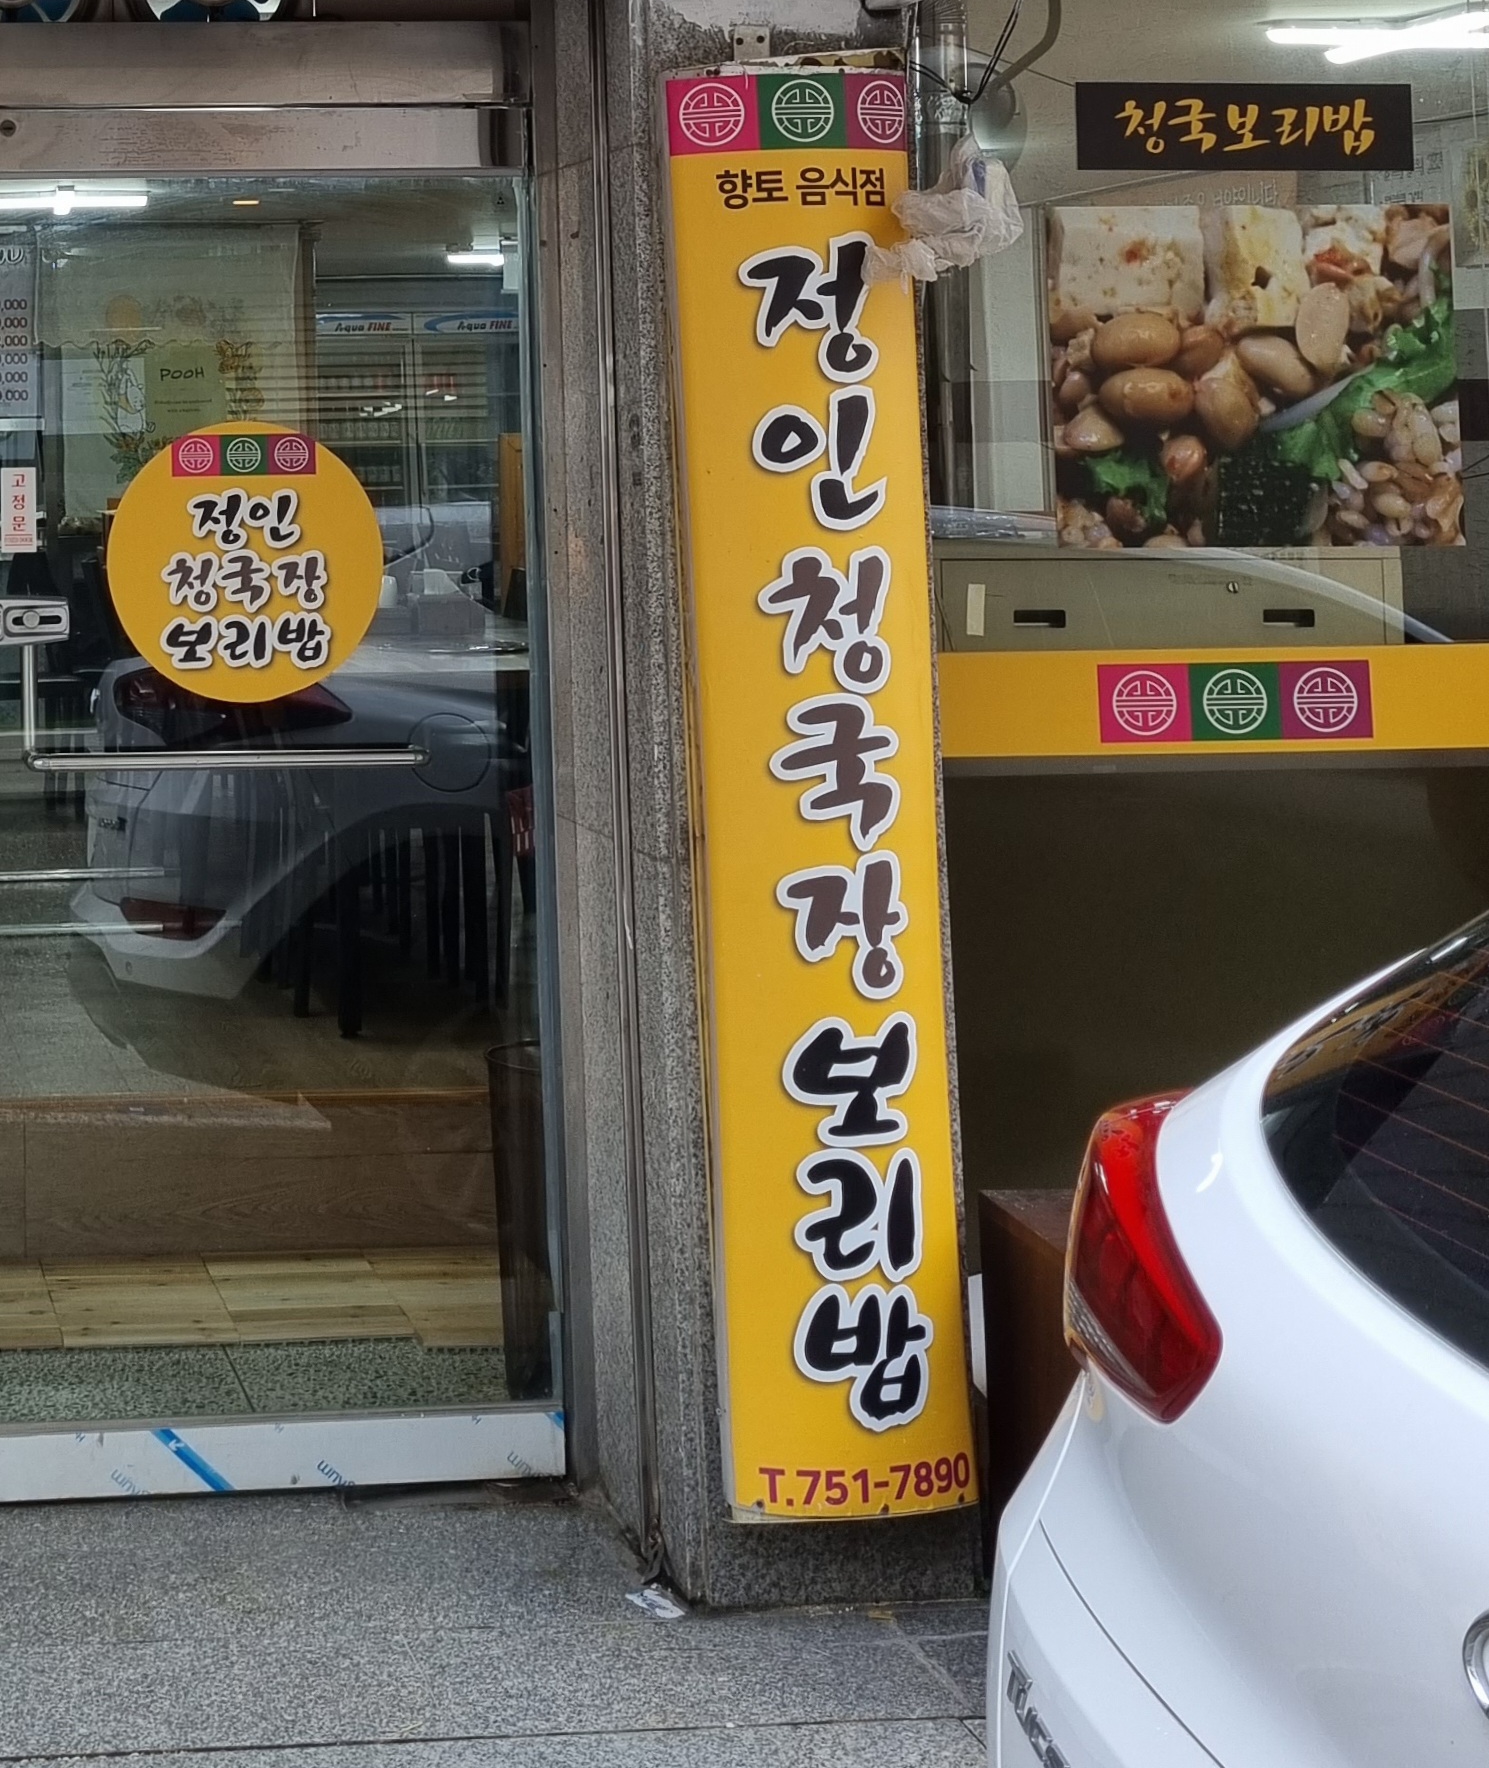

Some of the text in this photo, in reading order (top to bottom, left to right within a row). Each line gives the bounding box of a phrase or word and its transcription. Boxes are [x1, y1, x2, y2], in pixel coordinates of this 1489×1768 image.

[715, 166, 887, 210] 향토 음식점
[367, 322, 392, 331] FINE
[489, 319, 513, 330] FINE
[159, 366, 205, 381] POOH
[11, 473, 27, 532] 고정문
[187, 487, 301, 549] 정인
[161, 548, 328, 612] 청국장
[159, 611, 333, 672] 보리밥
[758, 1451, 972, 1509] T.751-7890
